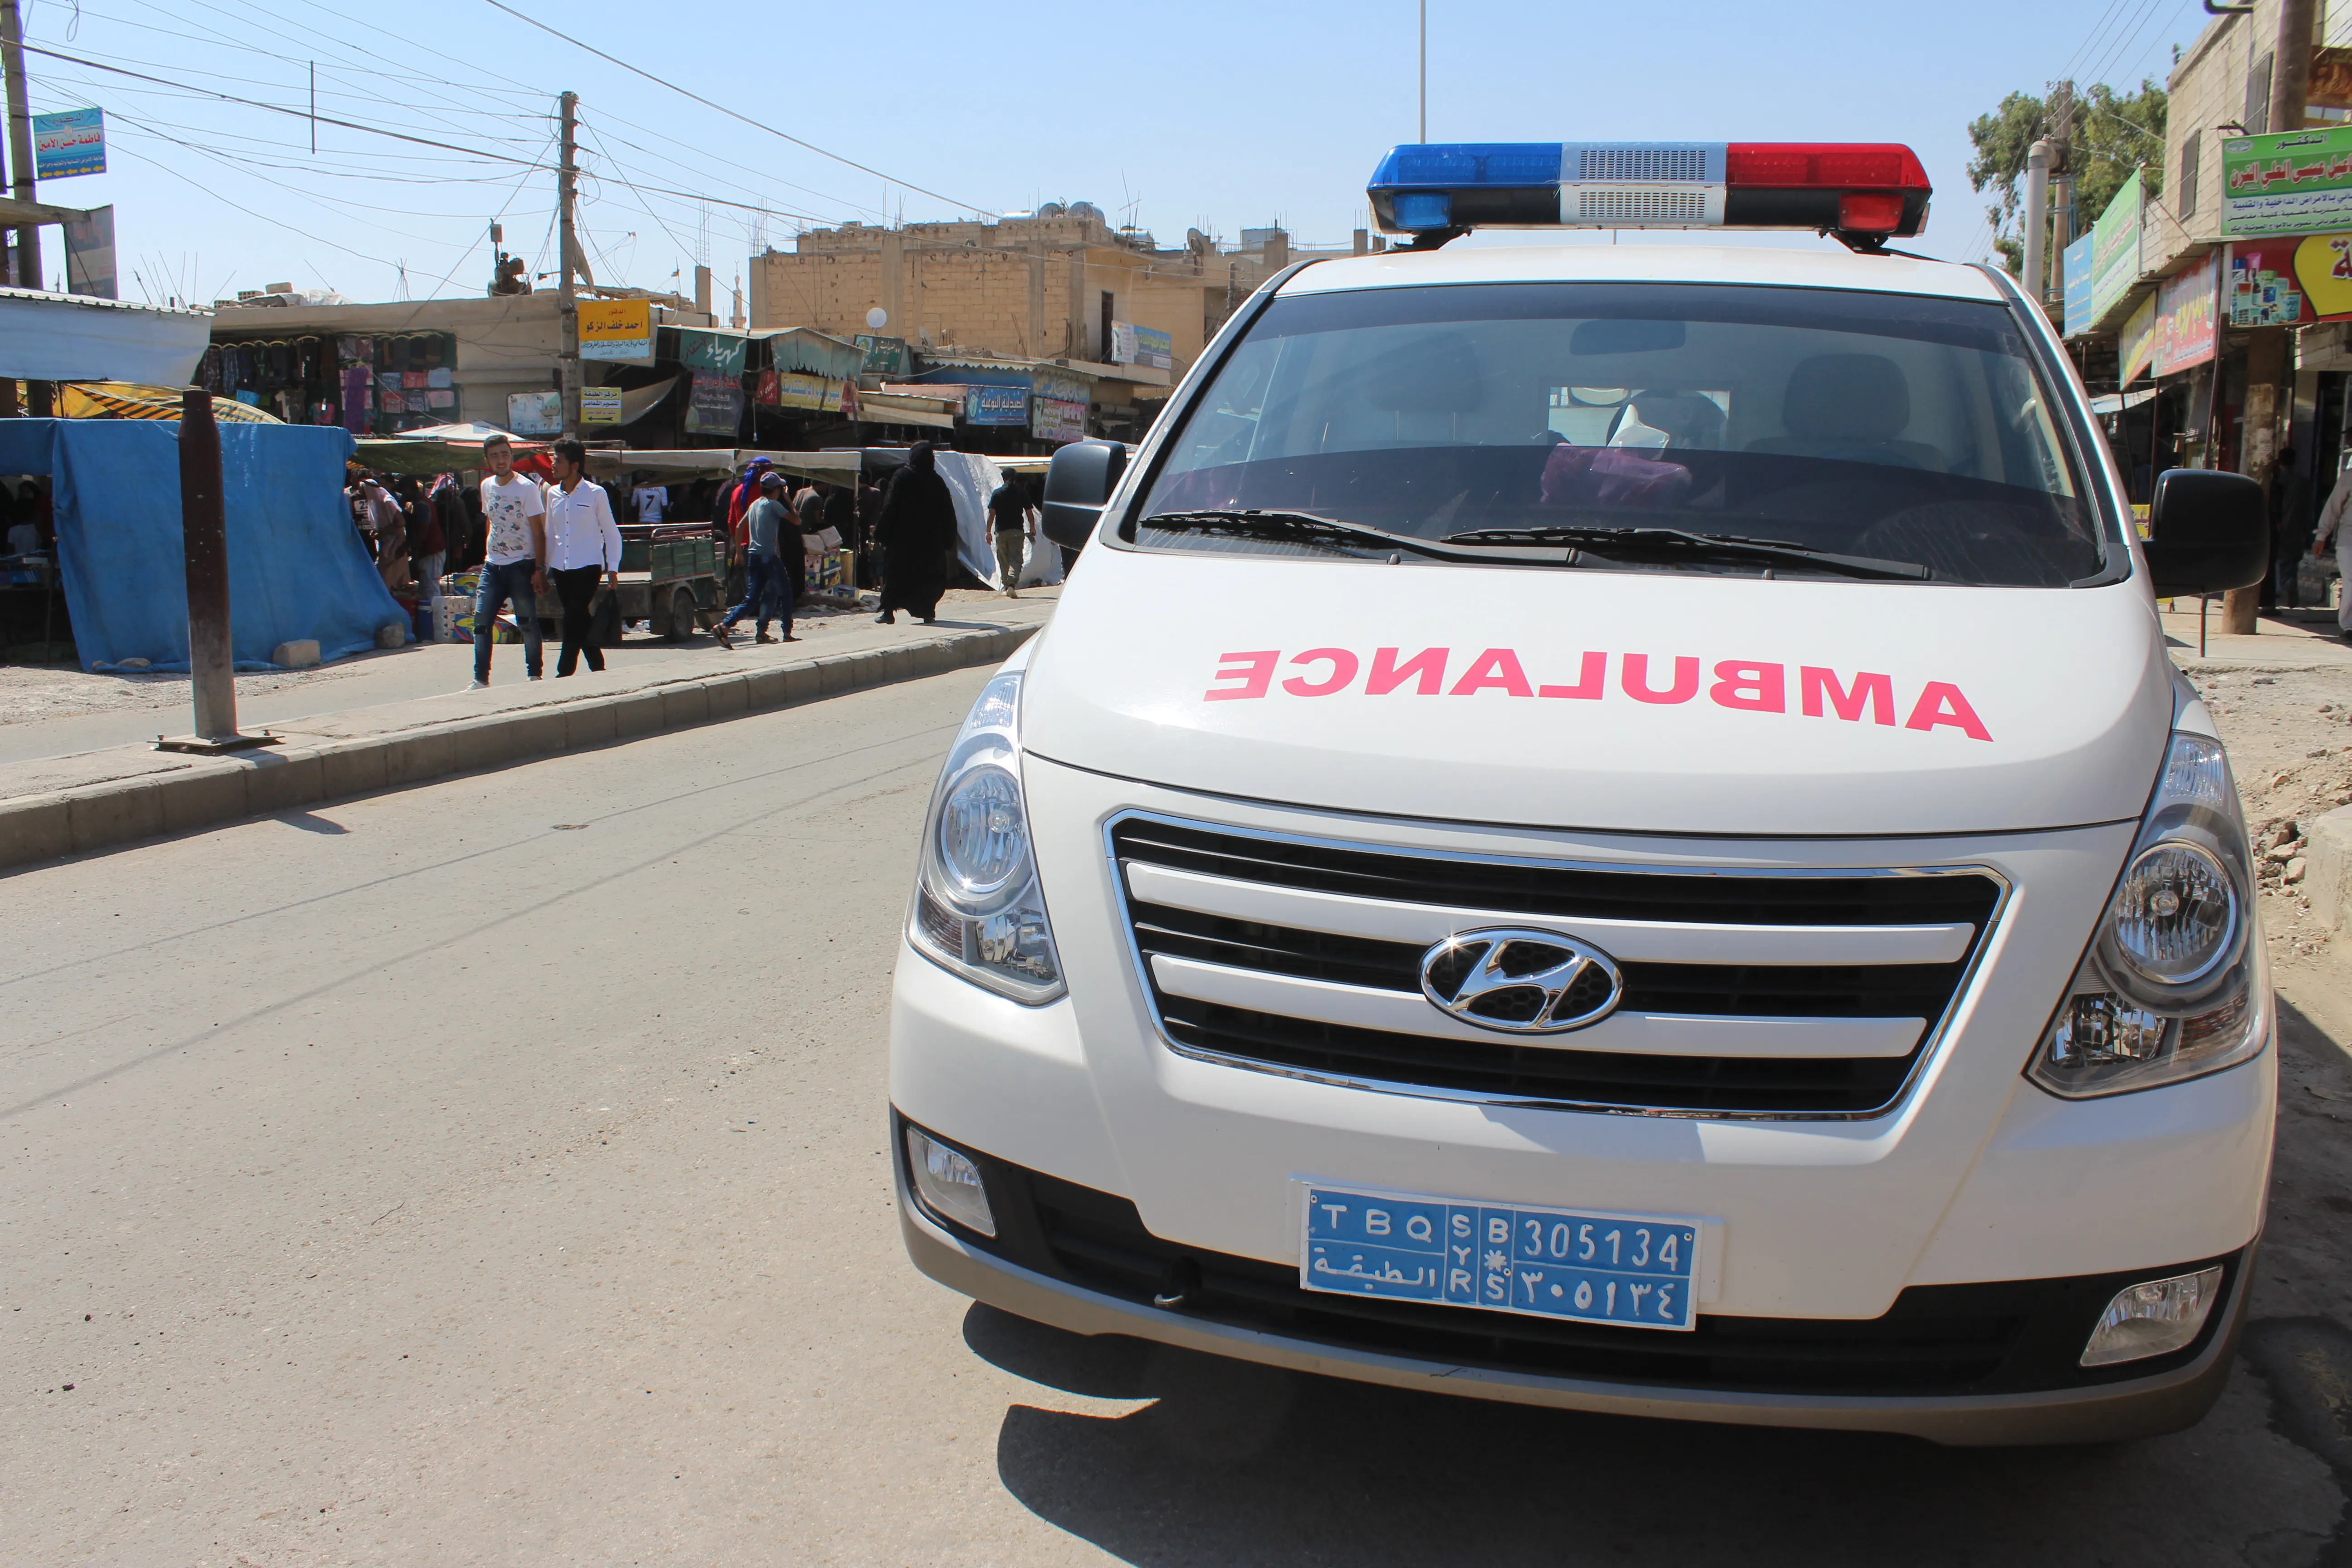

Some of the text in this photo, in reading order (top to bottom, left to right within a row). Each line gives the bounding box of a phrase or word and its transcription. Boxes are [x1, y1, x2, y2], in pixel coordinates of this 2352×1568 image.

[52, 112, 83, 127] الدكتورة
[60, 138, 76, 150] حسن
[78, 132, 101, 145] فاطمة
[2275, 134, 2328, 150] الدكتور
[2232, 200, 2263, 211] والقلبية
[2264, 197, 2298, 208] الداخلية
[607, 319, 623, 330] خلف
[625, 318, 643, 329] أحمد
[705, 334, 747, 368] كهرباء
[584, 390, 603, 398] الطبقة
[981, 393, 1025, 412] الصيدلية النوعية
[645, 495, 655, 511] 7
[1524, 1219, 1680, 1271] 305134
[1314, 1246, 1436, 1290] الطبقة
[1520, 1270, 1675, 1319] ٣٠٥١٣٤
